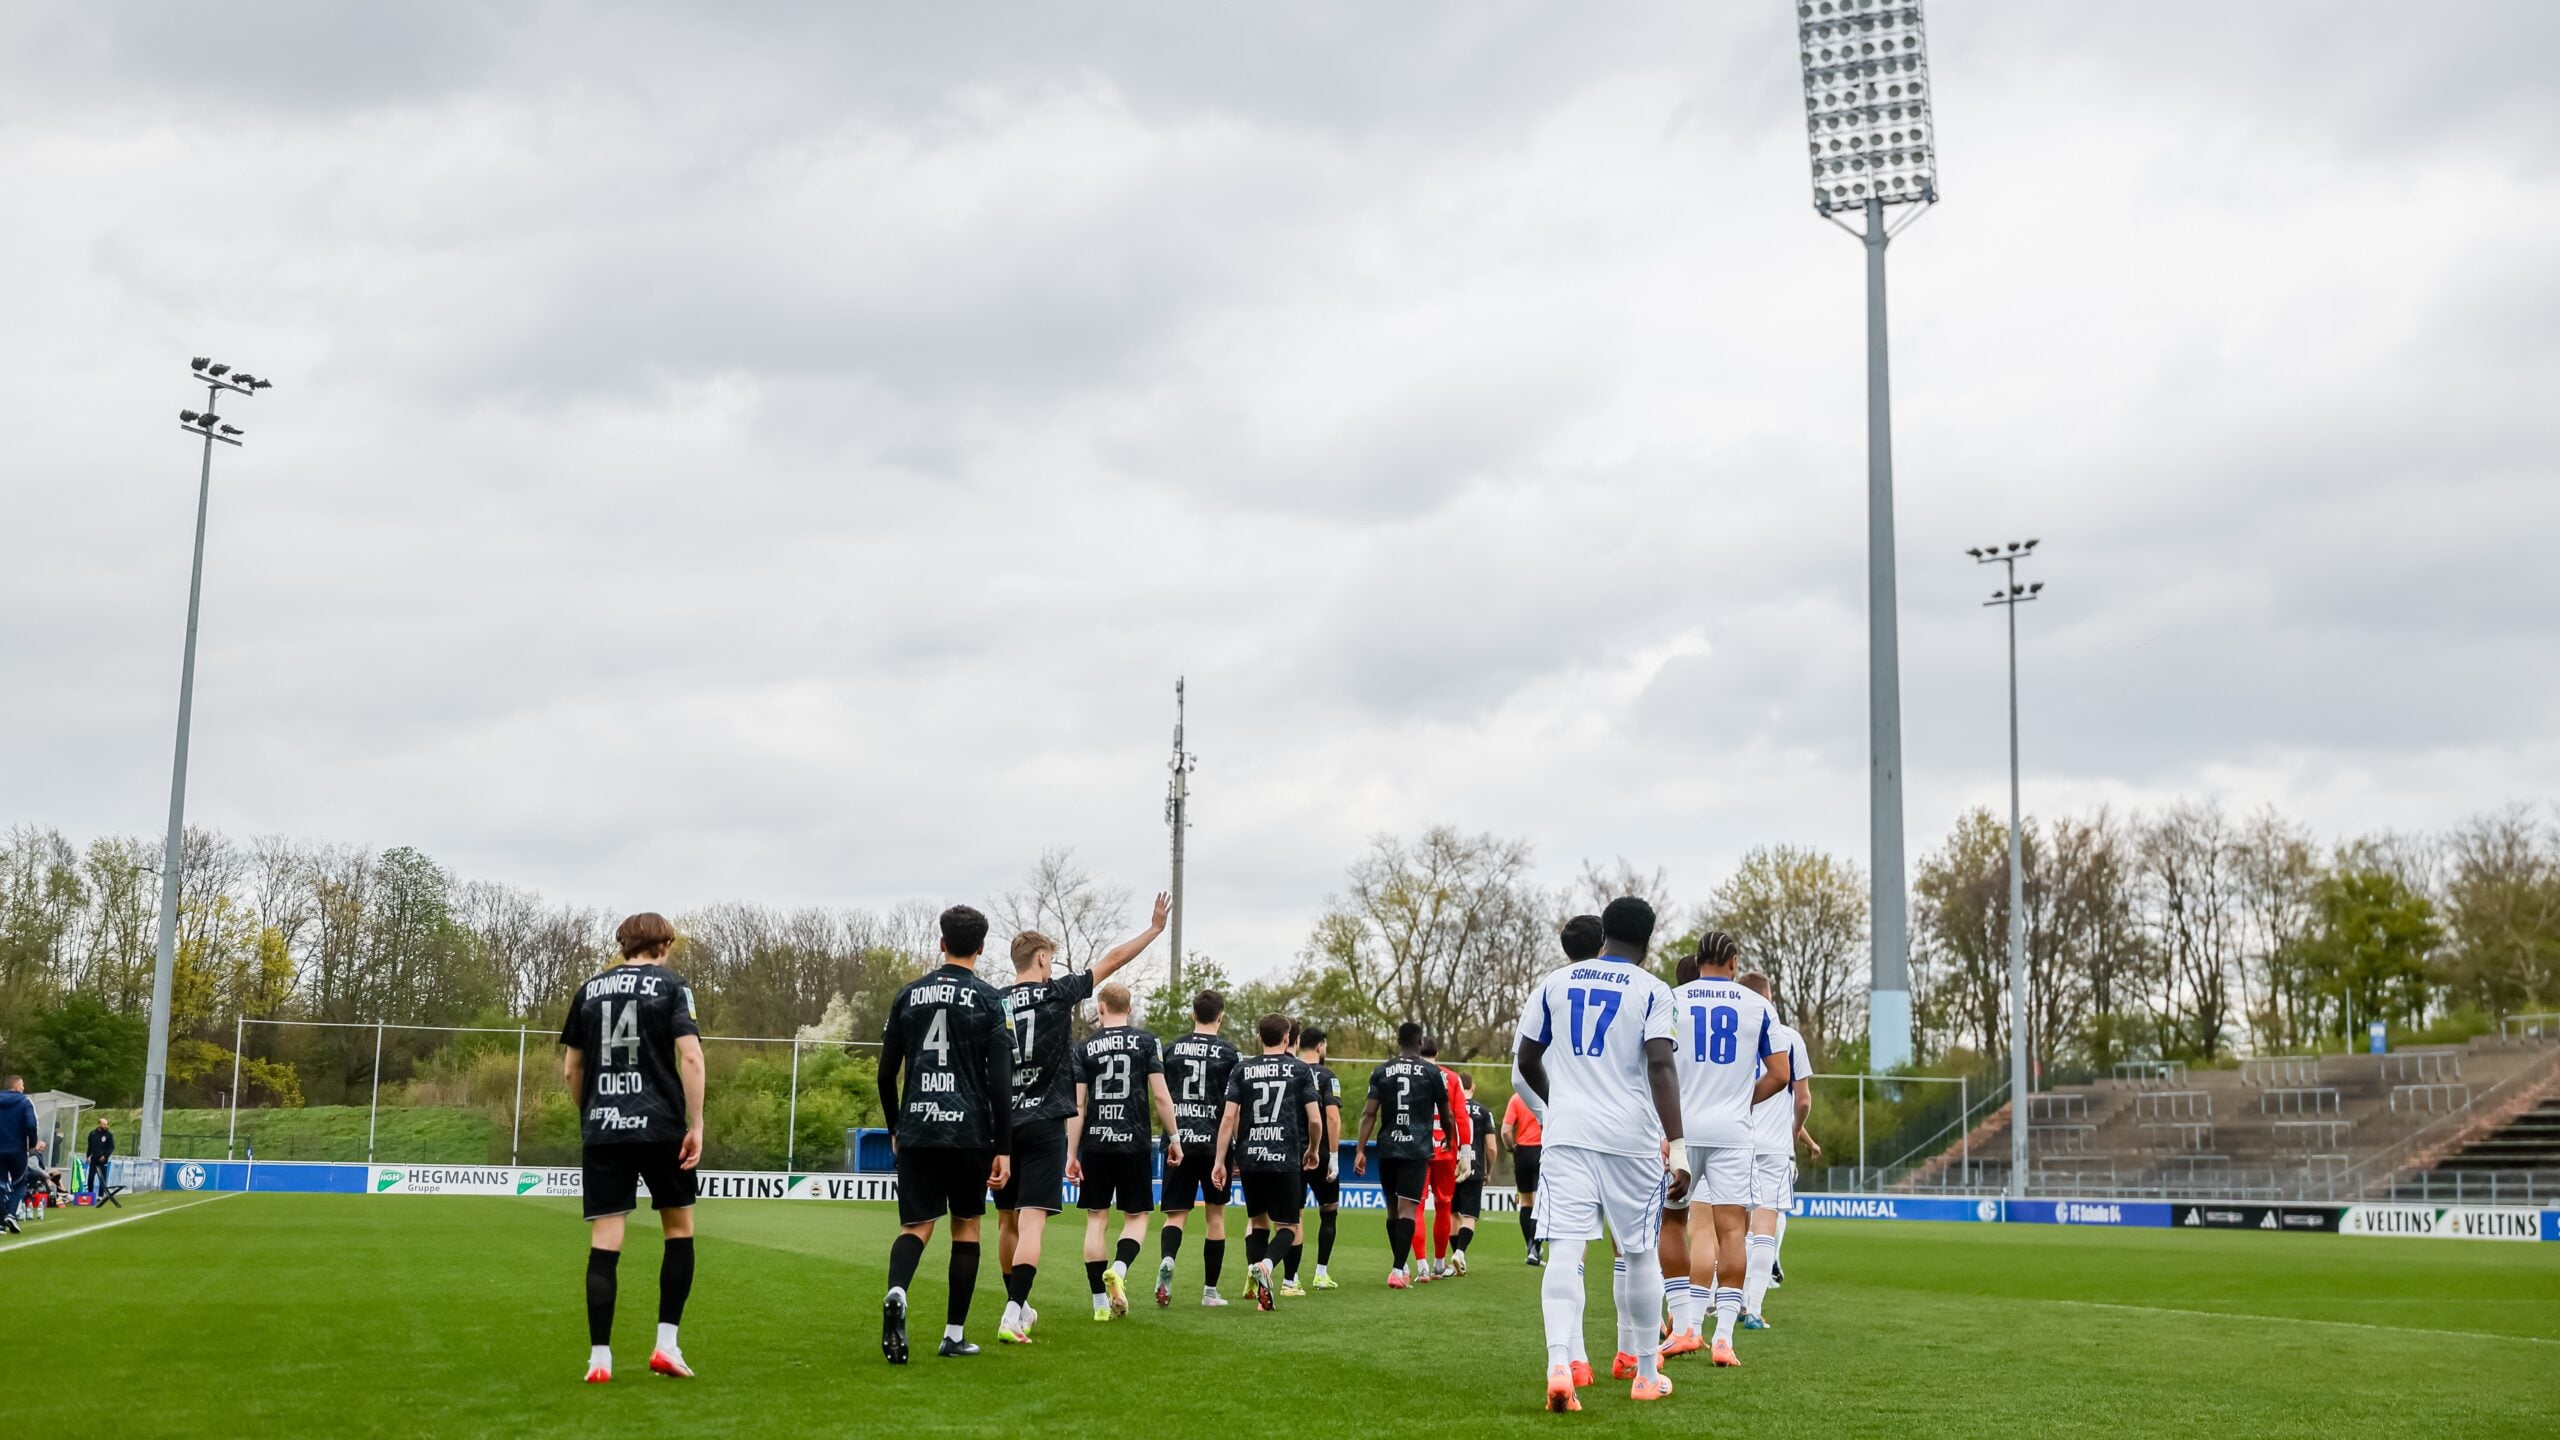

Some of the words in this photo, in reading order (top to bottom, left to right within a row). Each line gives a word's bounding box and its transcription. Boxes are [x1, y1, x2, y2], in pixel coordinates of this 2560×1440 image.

[586, 974, 637, 1000] BONNER
[640, 976, 662, 996] SC
[1570, 968, 1616, 982] SCHALKE
[1616, 973, 1630, 986] 04
[910, 984, 955, 1007] BONNER
[959, 988, 978, 1007] SC
[1688, 989, 1727, 999] SCHALKE
[1729, 991, 1741, 1000] 04
[601, 1000, 640, 1066] 14
[1567, 988, 1622, 1057] 17
[923, 1009, 950, 1066] 4
[1087, 1035, 1124, 1056] BONNER
[1127, 1035, 1139, 1050] SC
[1690, 1006, 1738, 1064] 18
[1174, 1043, 1207, 1056] BONNER
[1210, 1045, 1222, 1058] SC
[1095, 1054, 1131, 1100] 23
[1183, 1060, 1206, 1100] 21
[1244, 1064, 1279, 1080] BONNER
[1282, 1064, 1294, 1077] SC
[1413, 1065, 1424, 1076] SC
[598, 1072, 643, 1095] CUETO
[922, 1072, 954, 1092] BADR
[1252, 1081, 1286, 1124] 27
[1397, 1077, 1410, 1110] 2
[611, 1116, 648, 1129] TECH
[932, 1111, 964, 1122] TECH
[1108, 1133, 1133, 1142] TECH
[1249, 1127, 1284, 1141] POPOVIC
[1263, 1153, 1286, 1161] TECH
[408, 1169, 509, 1185] HEGMANNS
[696, 1177, 784, 1198] VELTINS
[408, 1184, 440, 1193] Gruppe
[546, 1186, 578, 1195] Gruppe
[828, 1179, 899, 1200] VELTIN
[1809, 1200, 1897, 1217] MINIMEAL
[2366, 1211, 2431, 1233] VELTINS
[2465, 1213, 2537, 1236] VELTINS
